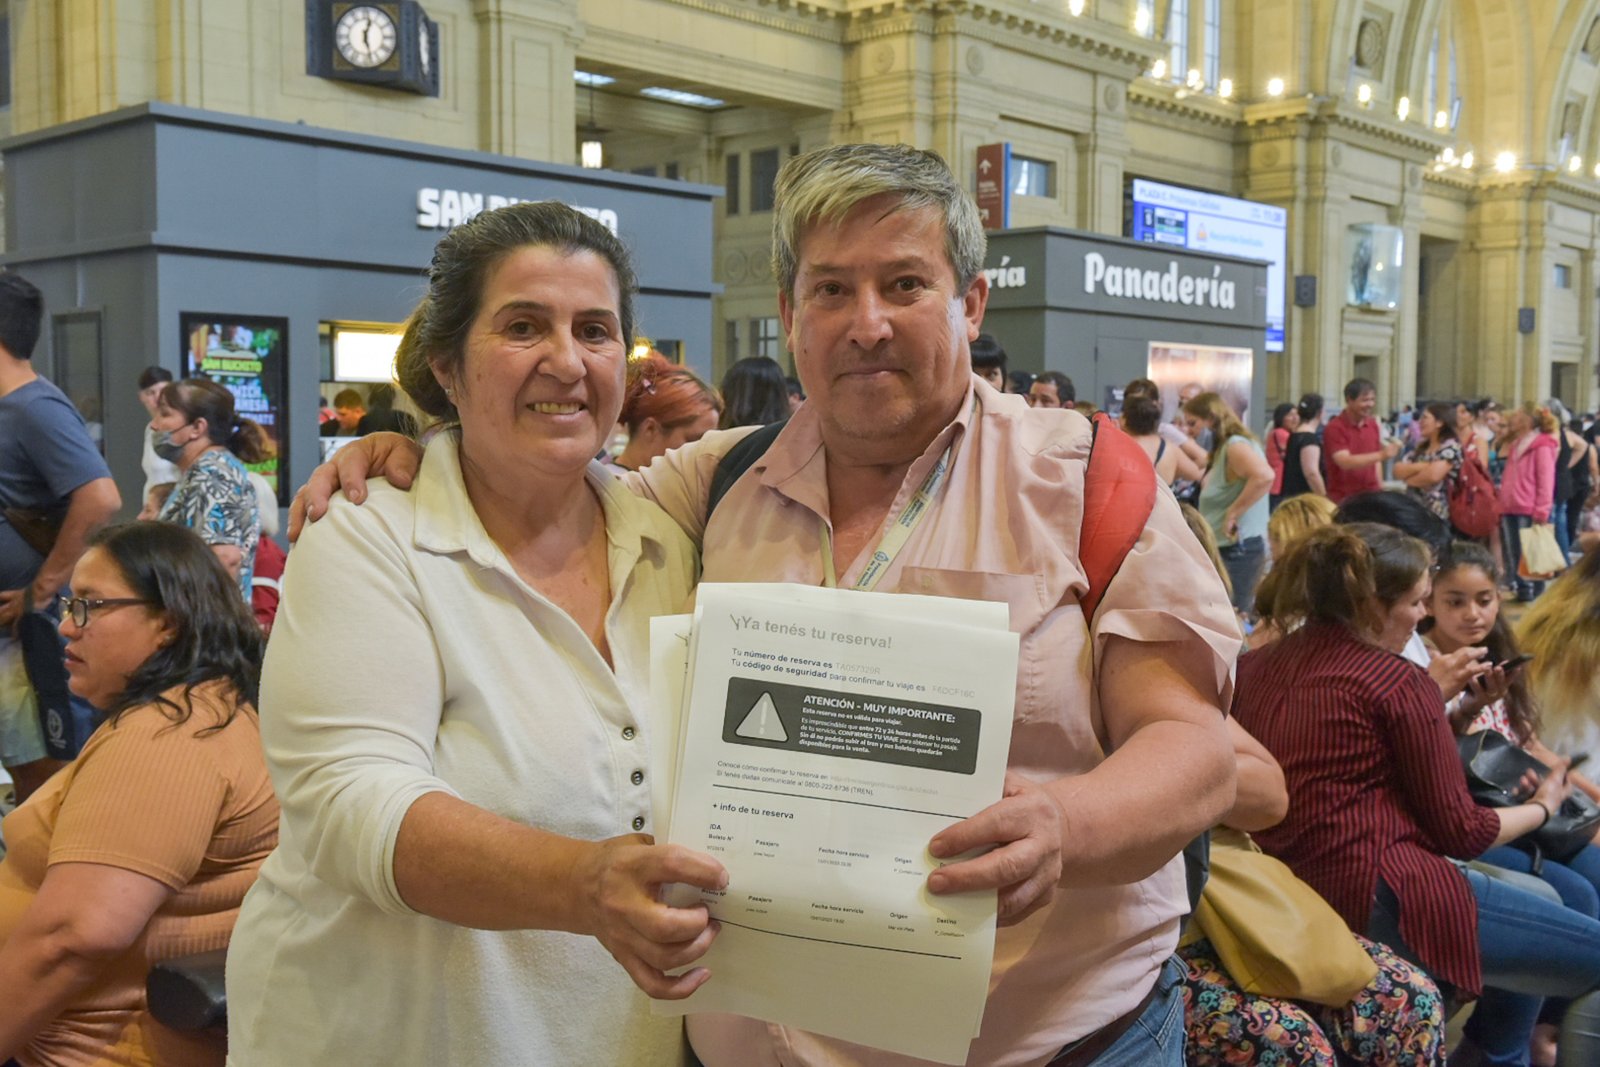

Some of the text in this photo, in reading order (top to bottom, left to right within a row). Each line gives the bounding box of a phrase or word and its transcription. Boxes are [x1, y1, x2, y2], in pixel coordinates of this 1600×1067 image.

[416, 187, 483, 228] SAN
[1084, 252, 1236, 310] Panadería
[765, 620, 806, 636] tenés
[811, 627, 826, 640] tu
[830, 632, 892, 648] reserva!
[744, 650, 776, 660] número
[778, 654, 788, 662] de
[790, 658, 820, 667] reserva
[743, 660, 771, 672] código
[774, 664, 784, 672] de
[786, 667, 827, 679] seguridad
[830, 674, 846, 682] para
[848, 675, 885, 686] confirmar
[804, 695, 855, 709] ATENCIÓN
[863, 703, 886, 714] MUY
[888, 706, 956, 723] IMPORTANTE:
[854, 713, 870, 722] válida
[885, 717, 902, 726] viajar.
[838, 730, 873, 738] CONFIRMES
[942, 736, 960, 744] partida
[799, 739, 831, 748] disponibles
[760, 765, 788, 775] confirmar
[797, 770, 819, 779] reserva
[720, 803, 736, 812] info
[762, 810, 794, 819] reserva
